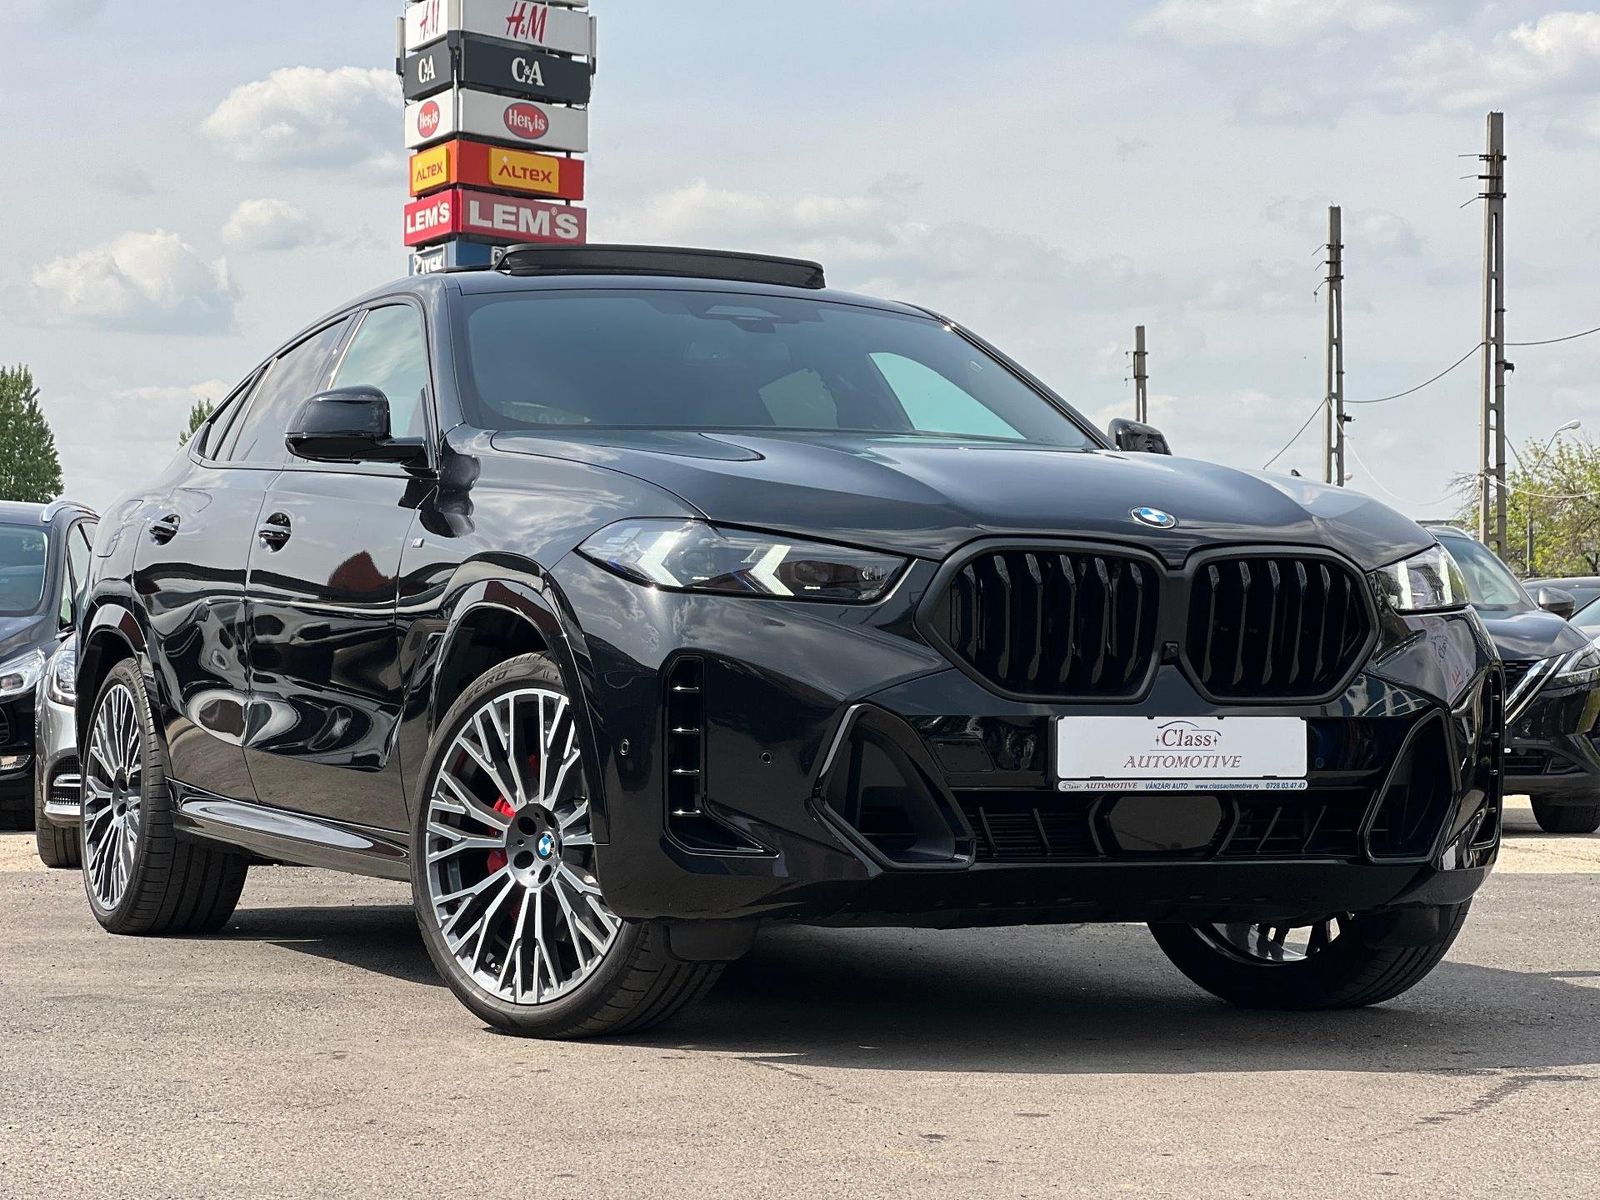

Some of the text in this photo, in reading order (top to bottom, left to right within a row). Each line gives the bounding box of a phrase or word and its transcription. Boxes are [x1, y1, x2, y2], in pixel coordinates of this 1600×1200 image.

[506, 1, 548, 44] H&M
[511, 57, 545, 86] C&A
[508, 109, 546, 133] Hervis
[406, 200, 451, 235] LEM'S
[1161, 728, 1212, 747] Class
[1123, 755, 1242, 769] AUTOMOTIVE
[1171, 782, 1188, 790] AUTO
